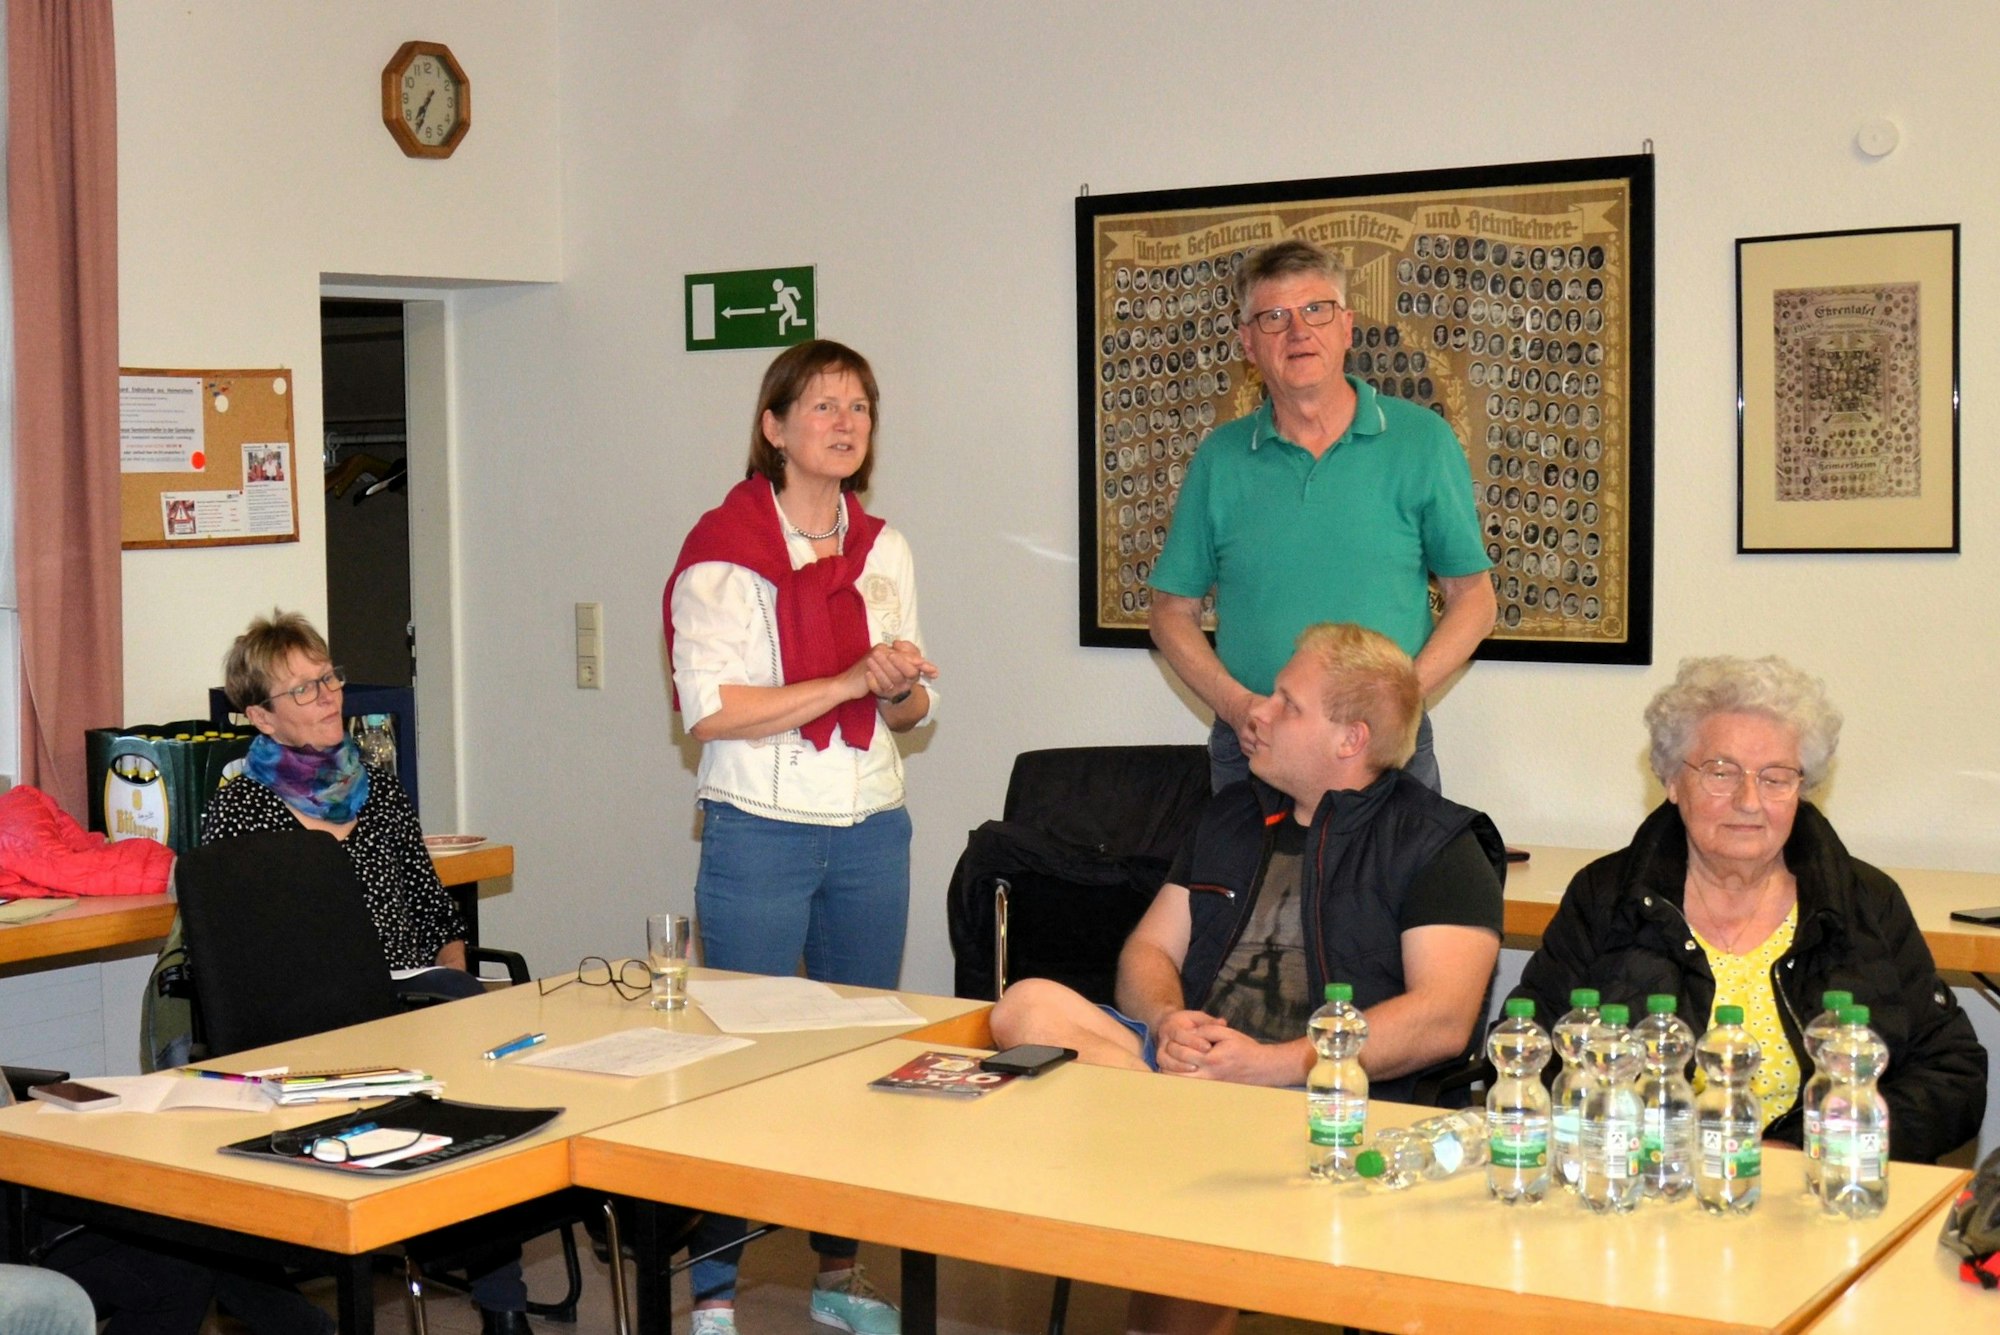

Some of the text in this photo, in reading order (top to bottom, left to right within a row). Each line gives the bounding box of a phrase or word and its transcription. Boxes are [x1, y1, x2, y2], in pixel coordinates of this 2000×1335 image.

[413, 64, 421, 76] 11
[423, 62, 432, 74] 12
[436, 65, 441, 78] 1
[404, 76, 415, 89] 10
[444, 79, 450, 92] 2
[402, 92, 409, 104] 9
[447, 96, 454, 109] 3
[405, 109, 412, 121] 8
[445, 114, 450, 125] 4
[425, 126, 432, 139] 6
[437, 124, 444, 136] 5
[1187, 221, 1273, 255] Gefallenen
[1425, 207, 1461, 229] und
